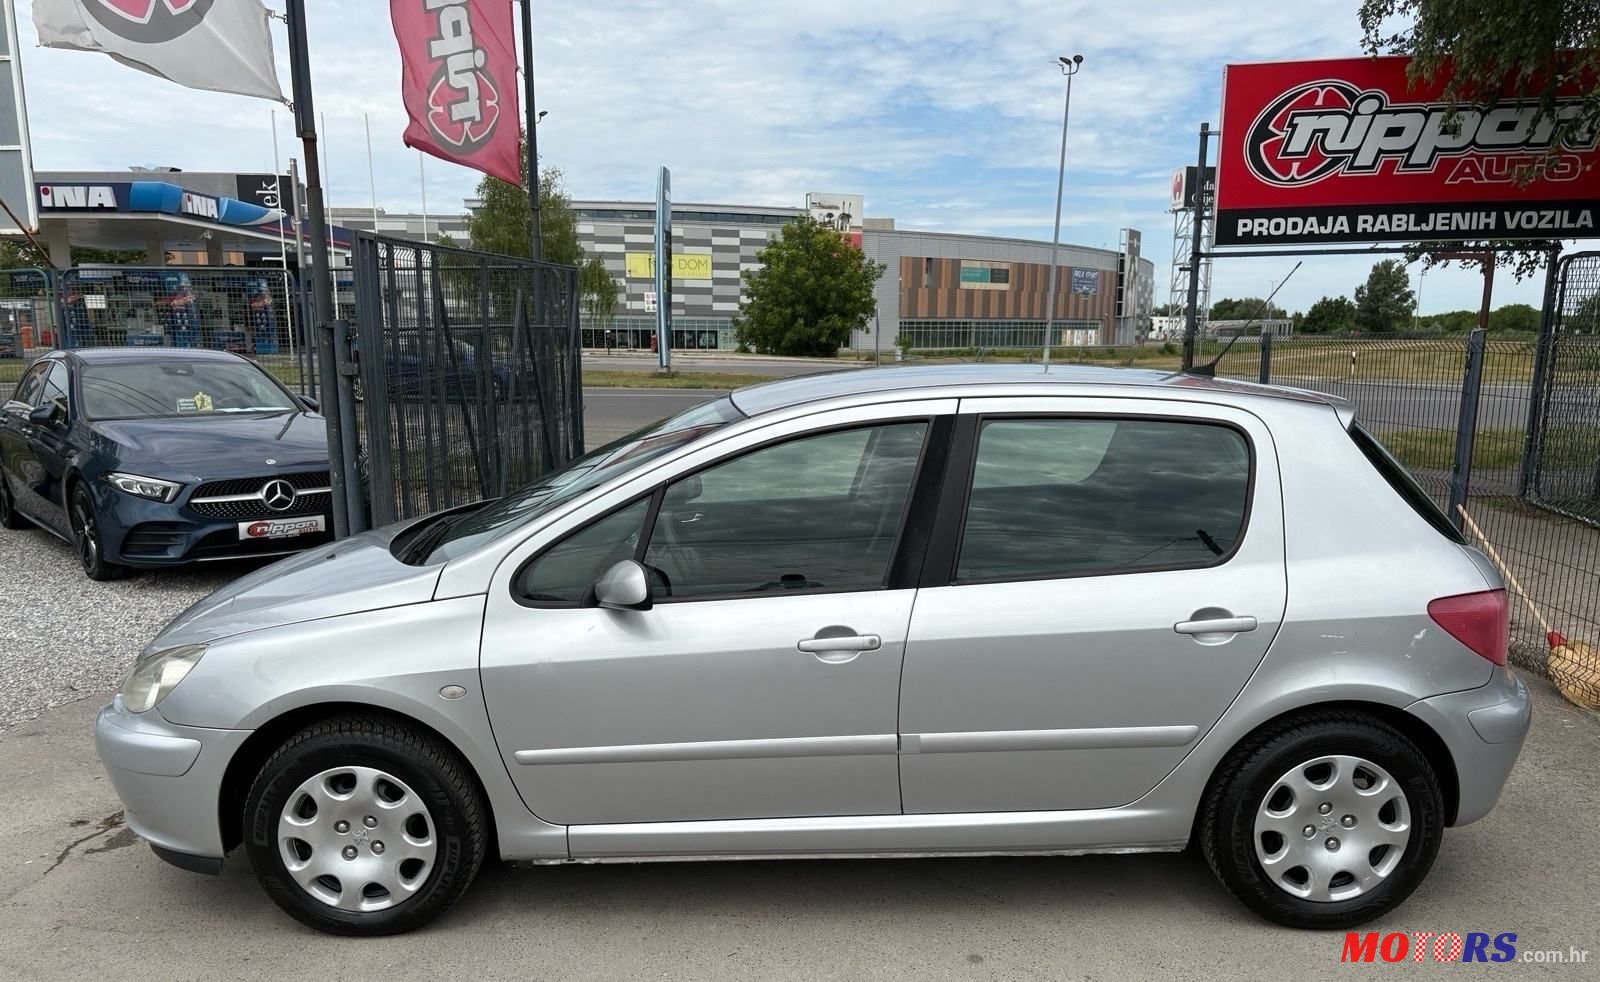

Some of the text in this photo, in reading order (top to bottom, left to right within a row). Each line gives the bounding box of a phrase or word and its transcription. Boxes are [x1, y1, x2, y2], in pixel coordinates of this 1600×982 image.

[1444, 154, 1582, 184] AUTO
[1237, 210, 1593, 237] PRODAJA RABLJENIH VOZILA
[679, 259, 708, 271] DOM
[256, 520, 317, 534] nippon
